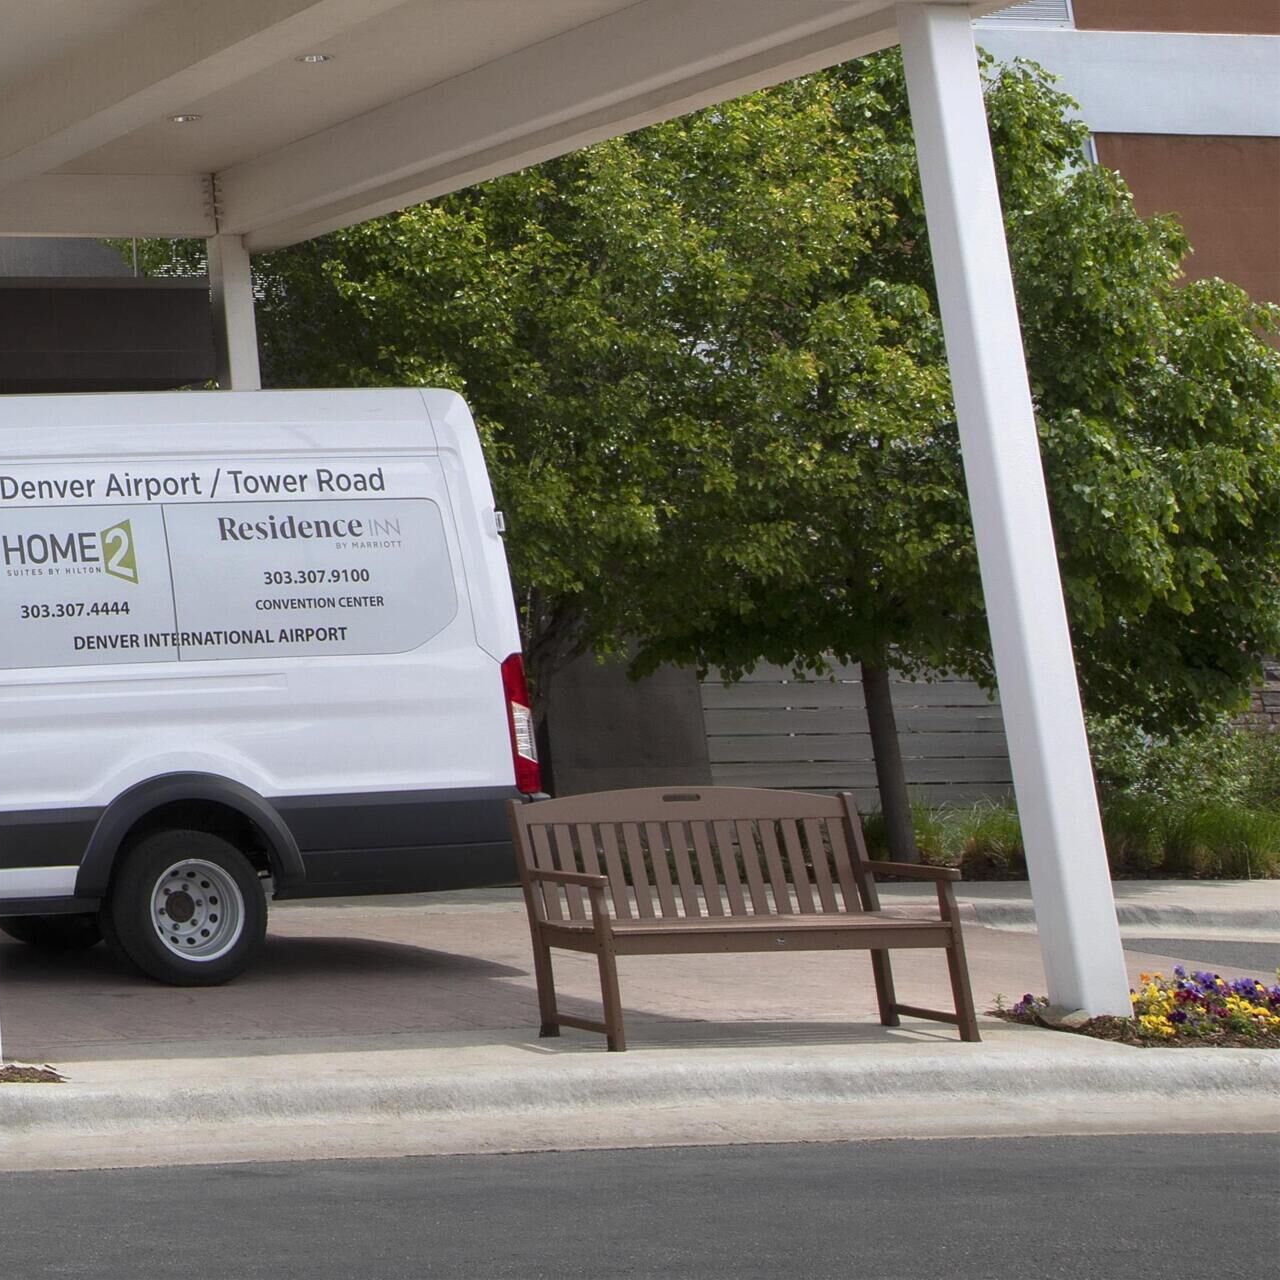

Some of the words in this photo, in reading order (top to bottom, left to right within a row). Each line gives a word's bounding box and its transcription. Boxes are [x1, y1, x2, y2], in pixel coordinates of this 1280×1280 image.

[0, 476, 95, 500] Denver
[105, 472, 202, 501] Airport
[227, 471, 308, 494] Tower
[316, 467, 385, 492] Road
[218, 515, 363, 541] Residence
[368, 518, 401, 537] INN
[2, 532, 100, 565] HOME
[105, 527, 134, 578] 2
[336, 542, 347, 550] BY
[352, 540, 402, 550] MARRIOTT
[7, 568, 43, 576] SUITES
[66, 566, 102, 574] HILTON
[264, 568, 370, 585] 303.307.9100
[21, 601, 130, 619] 303.307.4444
[255, 597, 336, 610] CONVENTION
[339, 596, 384, 608] CENTER
[73, 634, 140, 651] DENVER
[144, 630, 274, 648] INTERNATIONAL
[278, 627, 347, 644] AIRPORT
